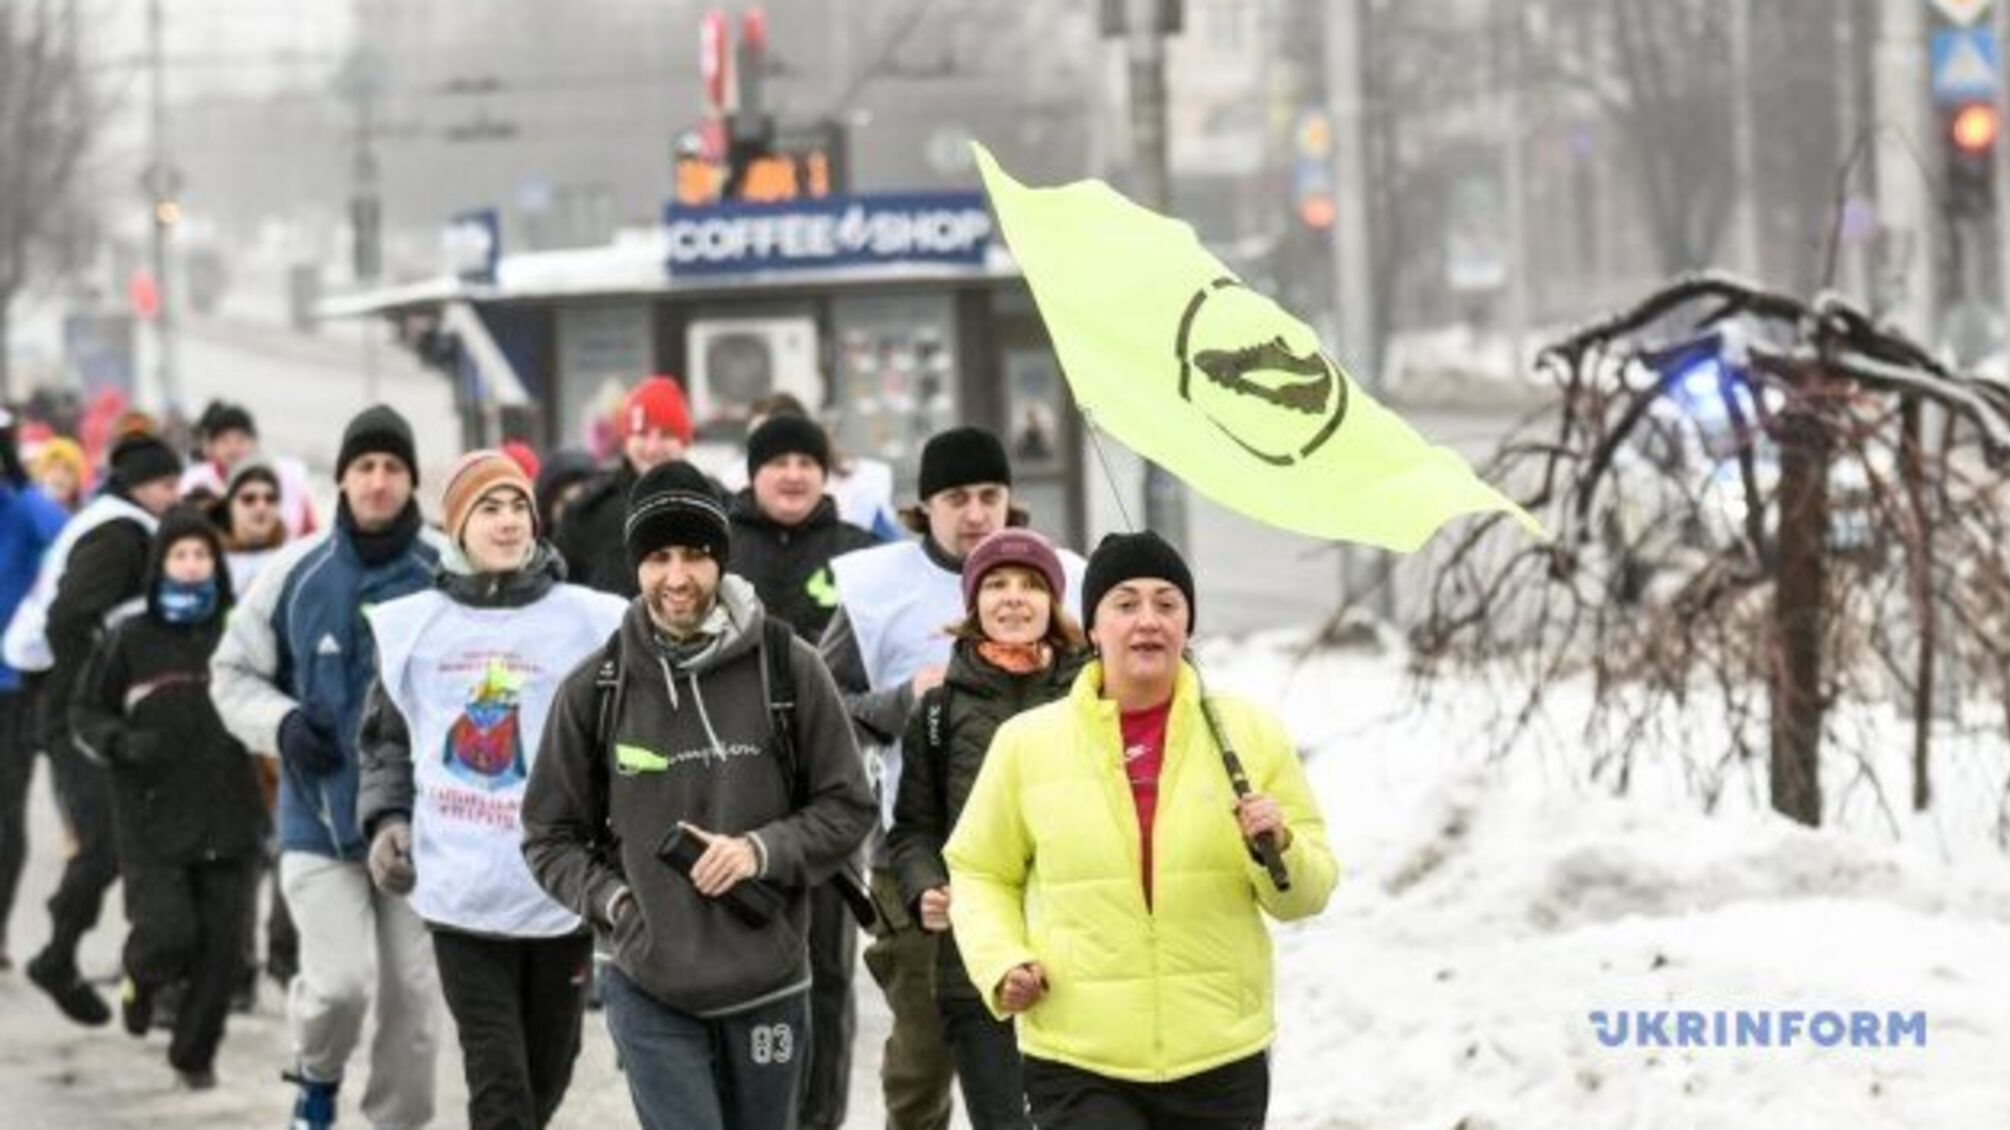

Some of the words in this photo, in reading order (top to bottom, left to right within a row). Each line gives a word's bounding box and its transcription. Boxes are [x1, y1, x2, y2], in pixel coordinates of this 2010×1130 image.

[669, 213, 837, 262] COFFEE
[870, 208, 991, 254] SHOP
[751, 1022, 794, 1063] 83
